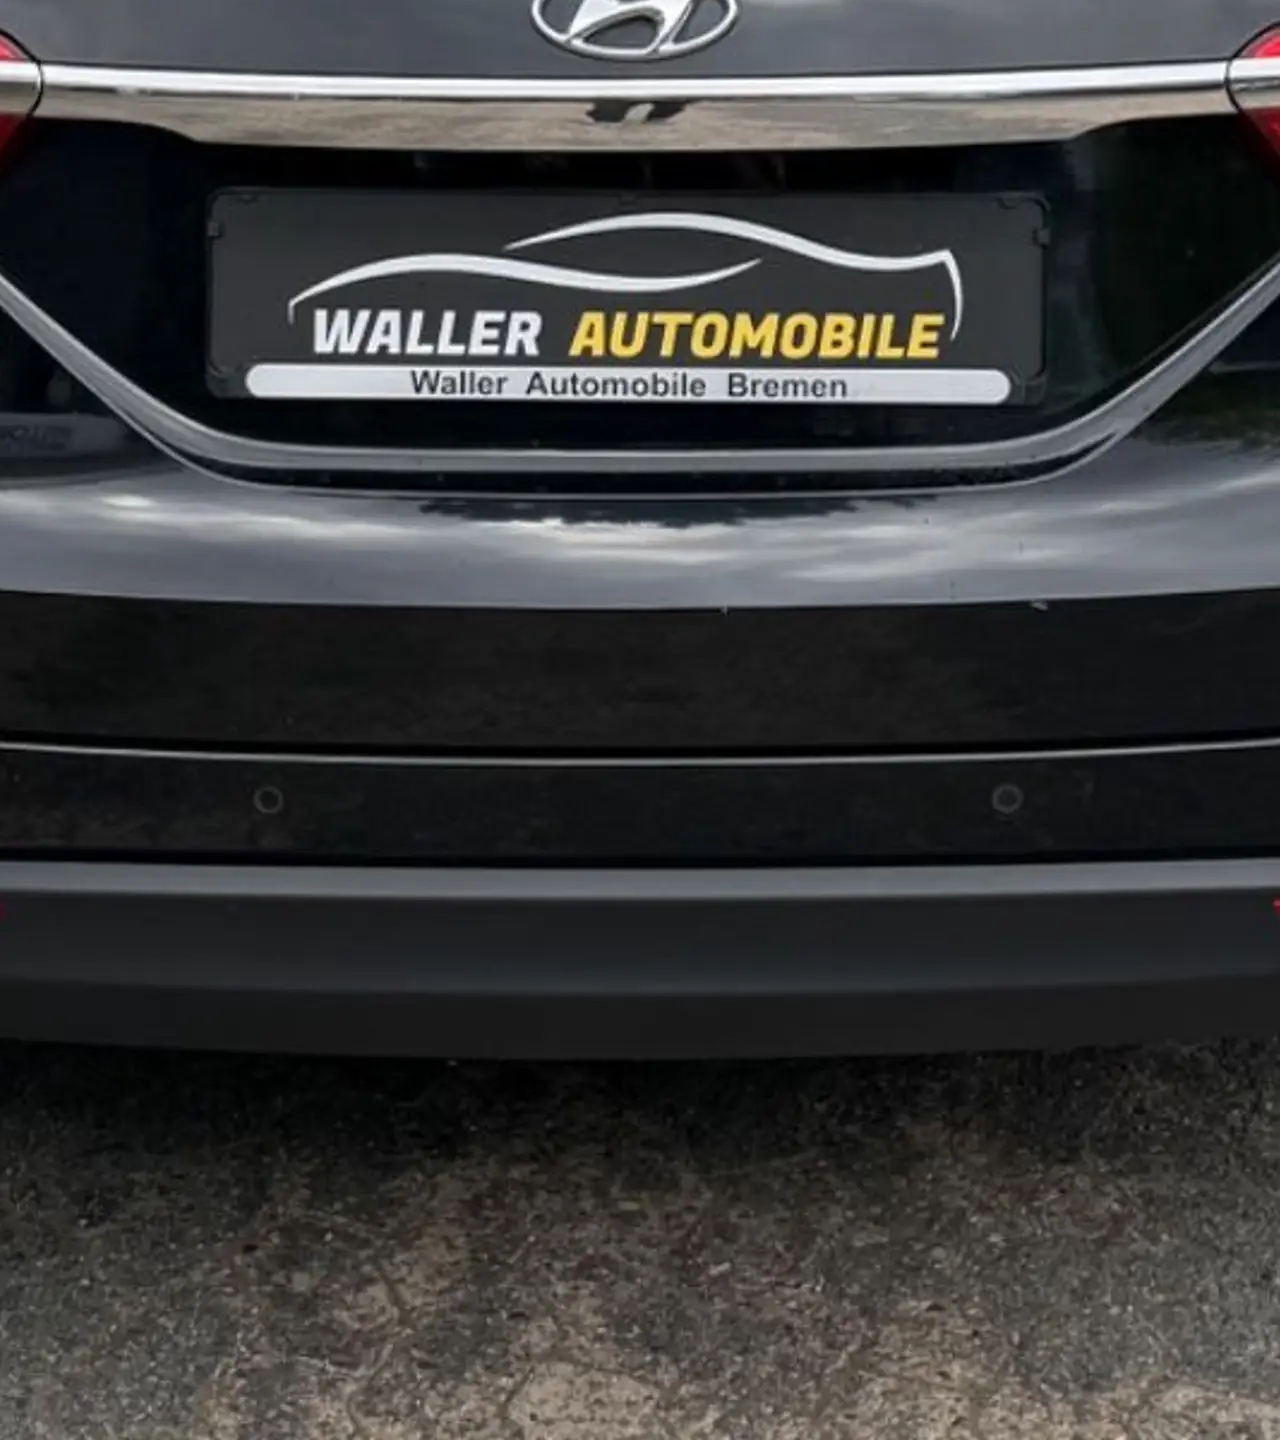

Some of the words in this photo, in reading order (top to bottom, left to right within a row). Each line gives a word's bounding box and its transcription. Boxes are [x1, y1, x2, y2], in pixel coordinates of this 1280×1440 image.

[313, 308, 543, 356] WALLER
[568, 311, 946, 359] AUTOMOBILE
[410, 369, 510, 397] Waller
[525, 371, 707, 398] Automobile
[727, 372, 848, 398] Bremen
